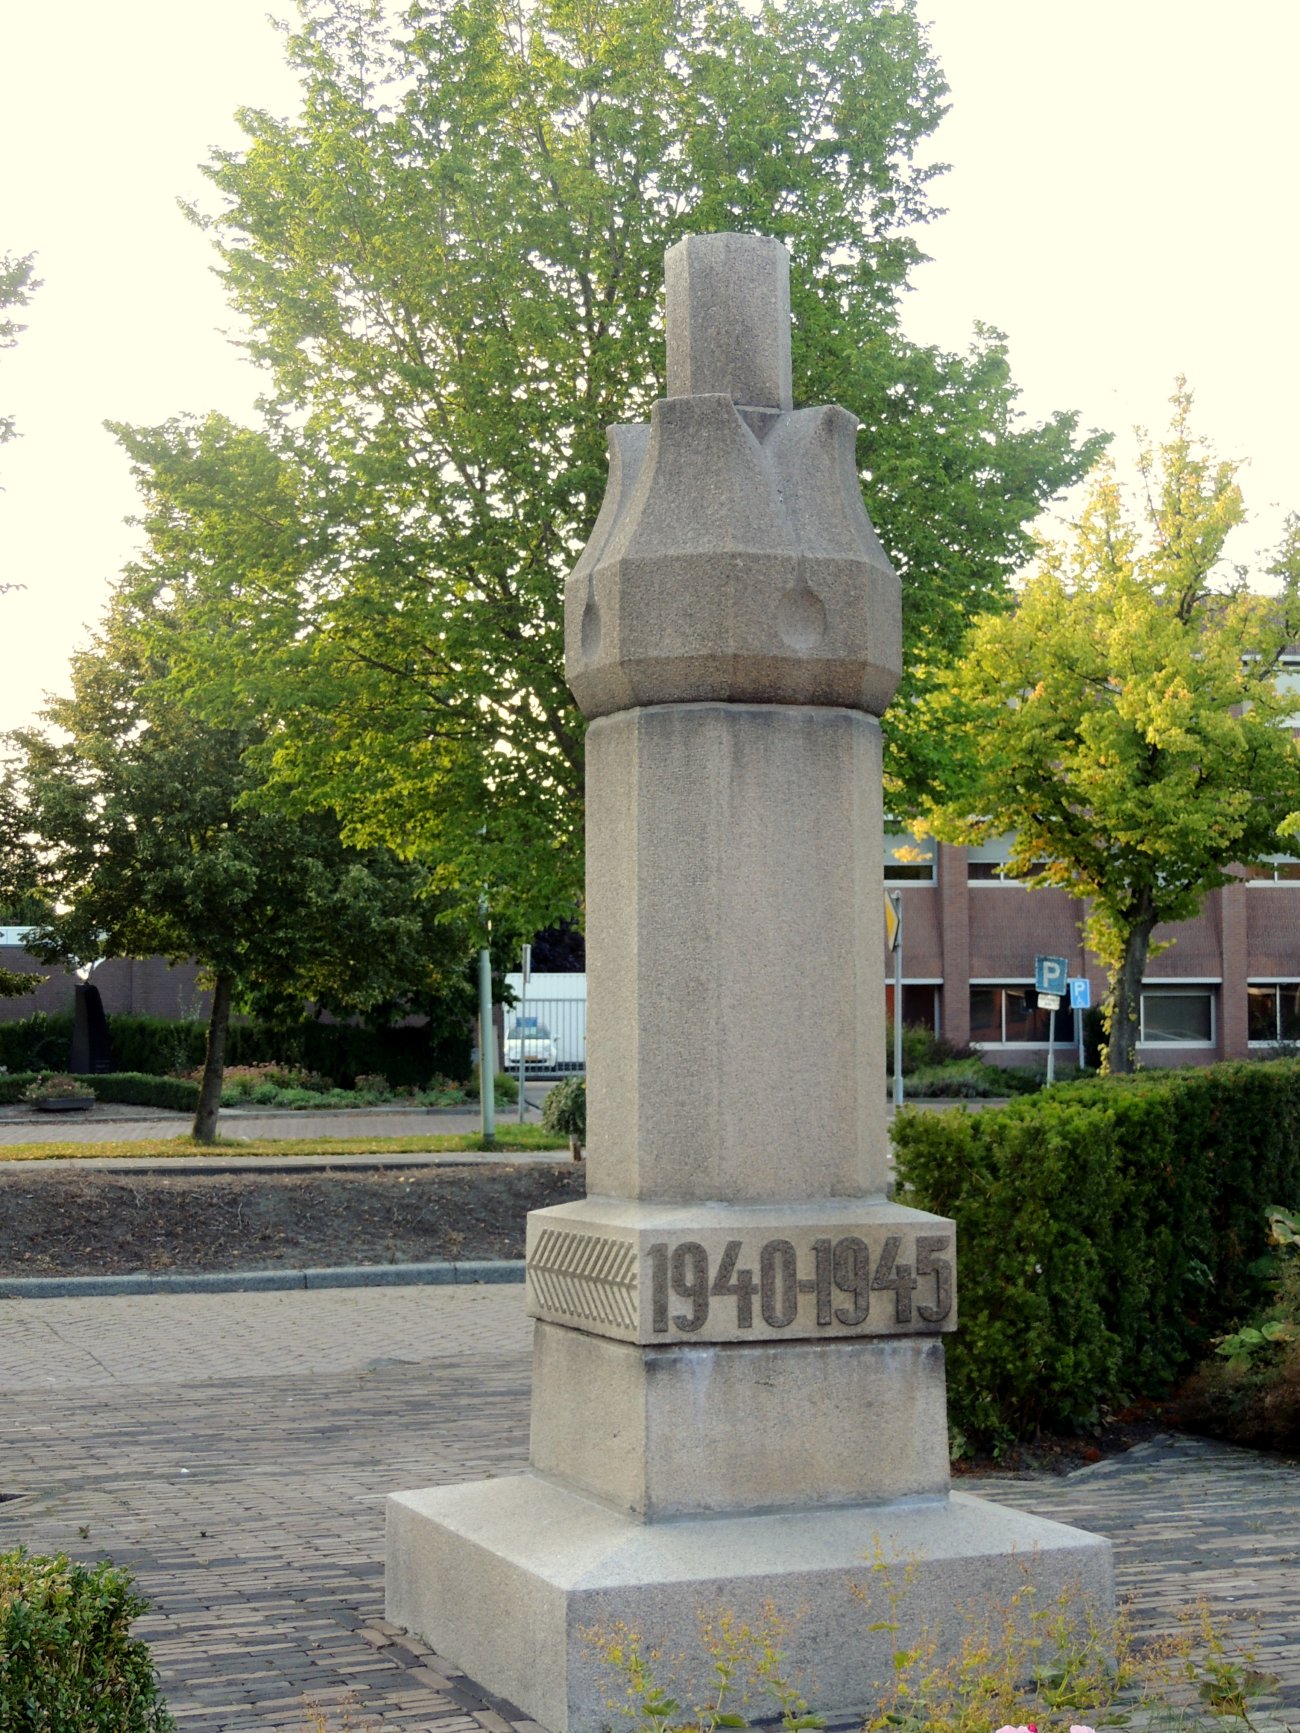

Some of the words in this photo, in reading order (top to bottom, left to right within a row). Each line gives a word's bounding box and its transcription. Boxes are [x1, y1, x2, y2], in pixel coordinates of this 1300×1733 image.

[1043, 961, 1060, 988] P
[1075, 981, 1085, 997] P
[646, 1235, 952, 1333] 1940-1945
